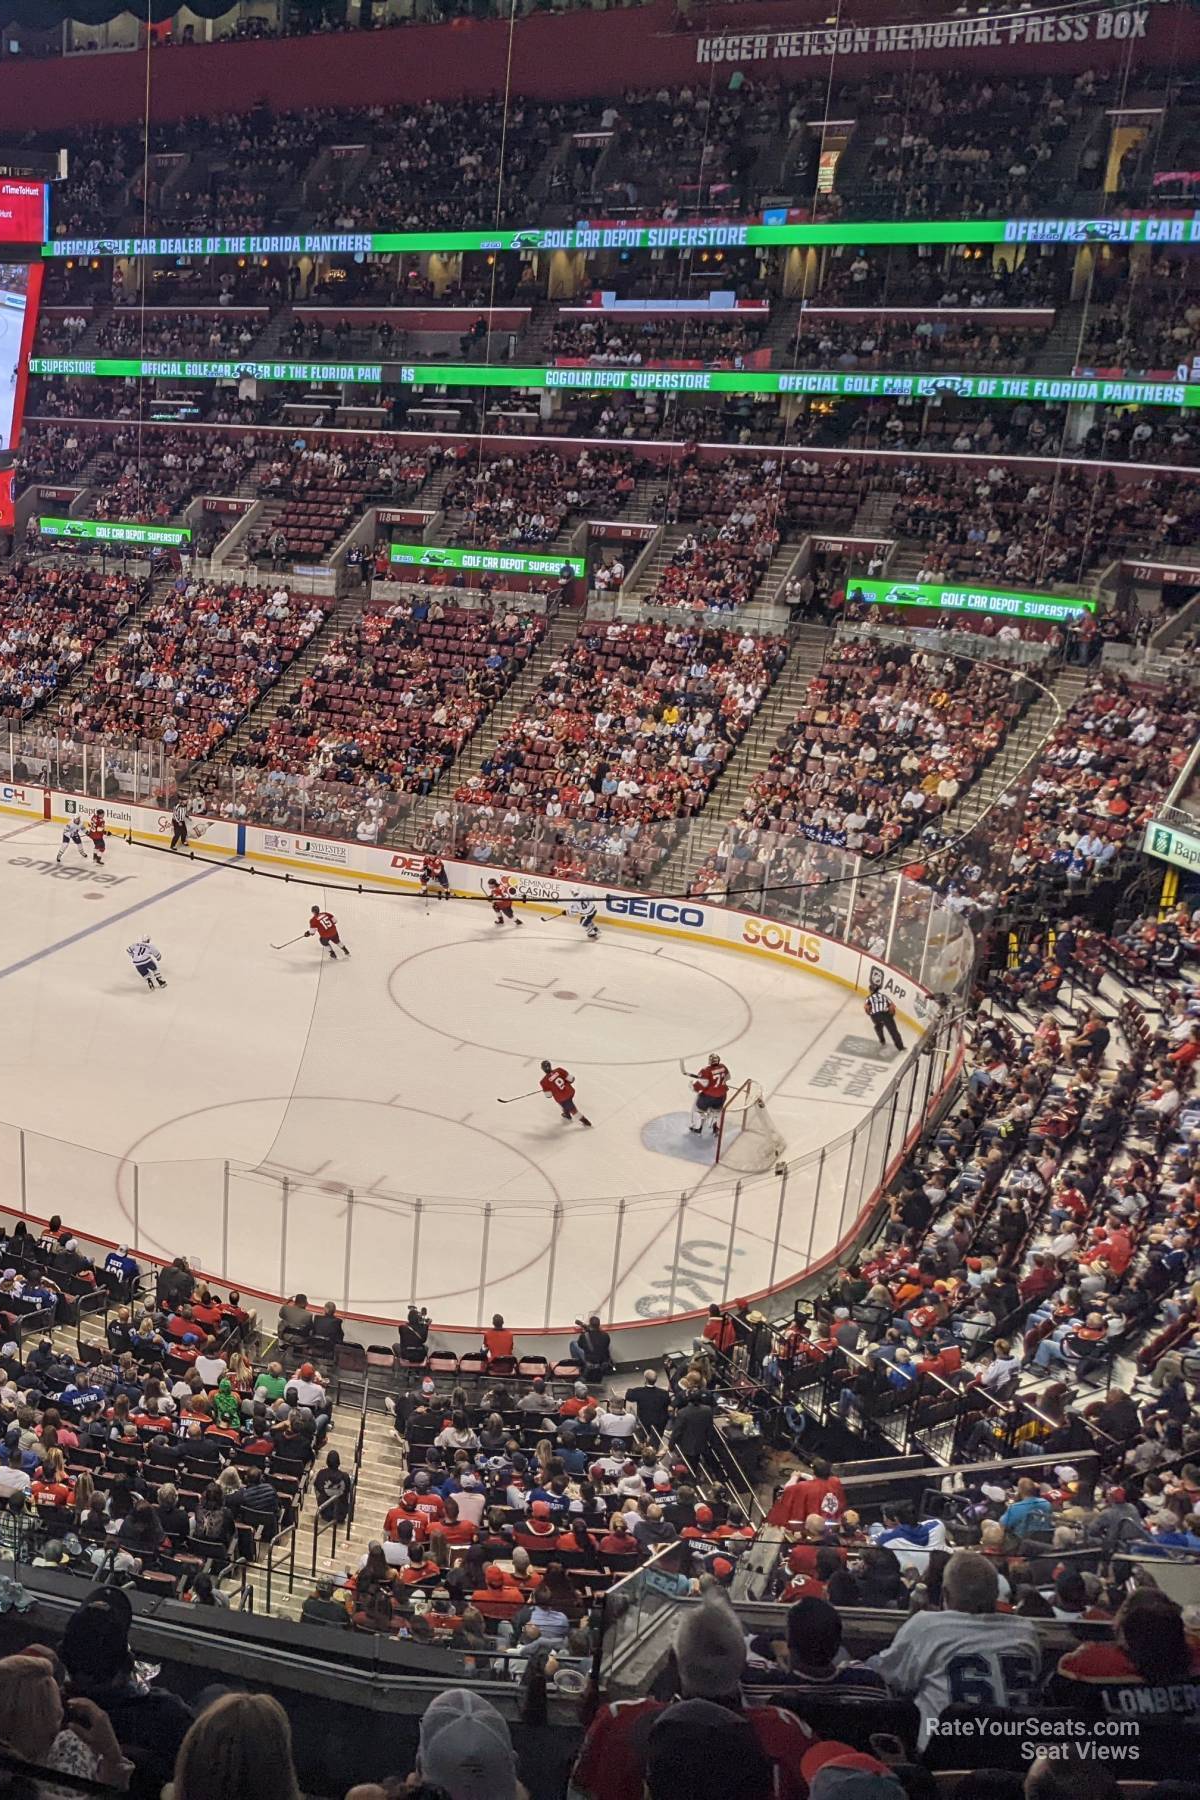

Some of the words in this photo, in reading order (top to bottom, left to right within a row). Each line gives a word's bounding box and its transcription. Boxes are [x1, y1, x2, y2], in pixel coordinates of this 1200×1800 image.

[773, 29, 872, 57] NEILSON
[876, 20, 1002, 52] MEMORIAL
[1008, 14, 1088, 45] PRESS
[1097, 10, 1149, 39] BOX
[2, 184, 39, 196] #TimeToHunt
[544, 231, 574, 248] GOLF
[575, 230, 600, 248] CAR
[603, 229, 644, 247] DEPOT
[647, 226, 748, 246] SUPERSTORE
[1145, 220, 1184, 241] CAR
[134, 239, 156, 254] CAR
[160, 238, 202, 254] DEALER
[206, 237, 221, 253] OF
[224, 237, 246, 252] THE
[250, 236, 300, 252] FLORIDA
[305, 235, 372, 251] PANTHERS
[42, 360, 96, 373] SUPERSTORE
[141, 363, 182, 376] OFFICIAL
[274, 365, 286, 379] OF
[289, 366, 307, 379] THE
[311, 366, 355, 380] FLORIDA
[594, 371, 625, 387] DEPOT
[630, 372, 711, 389] SUPERSTORE
[779, 375, 839, 392] OFFICIAL
[844, 376, 878, 393] GOLF
[978, 380, 997, 396] OF
[1002, 380, 1028, 397] THE
[1033, 381, 1097, 399] FLORIDA
[1103, 383, 1185, 402] PANTHERS
[379, 513, 391, 523] 118
[96, 527, 111, 538] GOLF
[112, 528, 125, 540] CAR
[126, 530, 145, 542] DEPOT
[591, 526, 605, 536] 119
[815, 541, 832, 551] 120
[462, 554, 480, 567] GOLF
[483, 556, 499, 569] CAR
[500, 558, 526, 572] DEPOT
[1134, 567, 1150, 578] 121
[941, 592, 965, 606] GOLF
[968, 594, 988, 609] CAR
[990, 597, 1022, 613] DEPOT
[3, 787, 24, 801] CH
[107, 808, 132, 822] Health
[310, 841, 346, 856] SYLVESTER
[520, 877, 561, 891] SEMINOLE
[518, 887, 560, 899] CASINO
[606, 893, 704, 928] GEICO
[320, 916, 333, 930] 15
[742, 919, 821, 963] SOLIS
